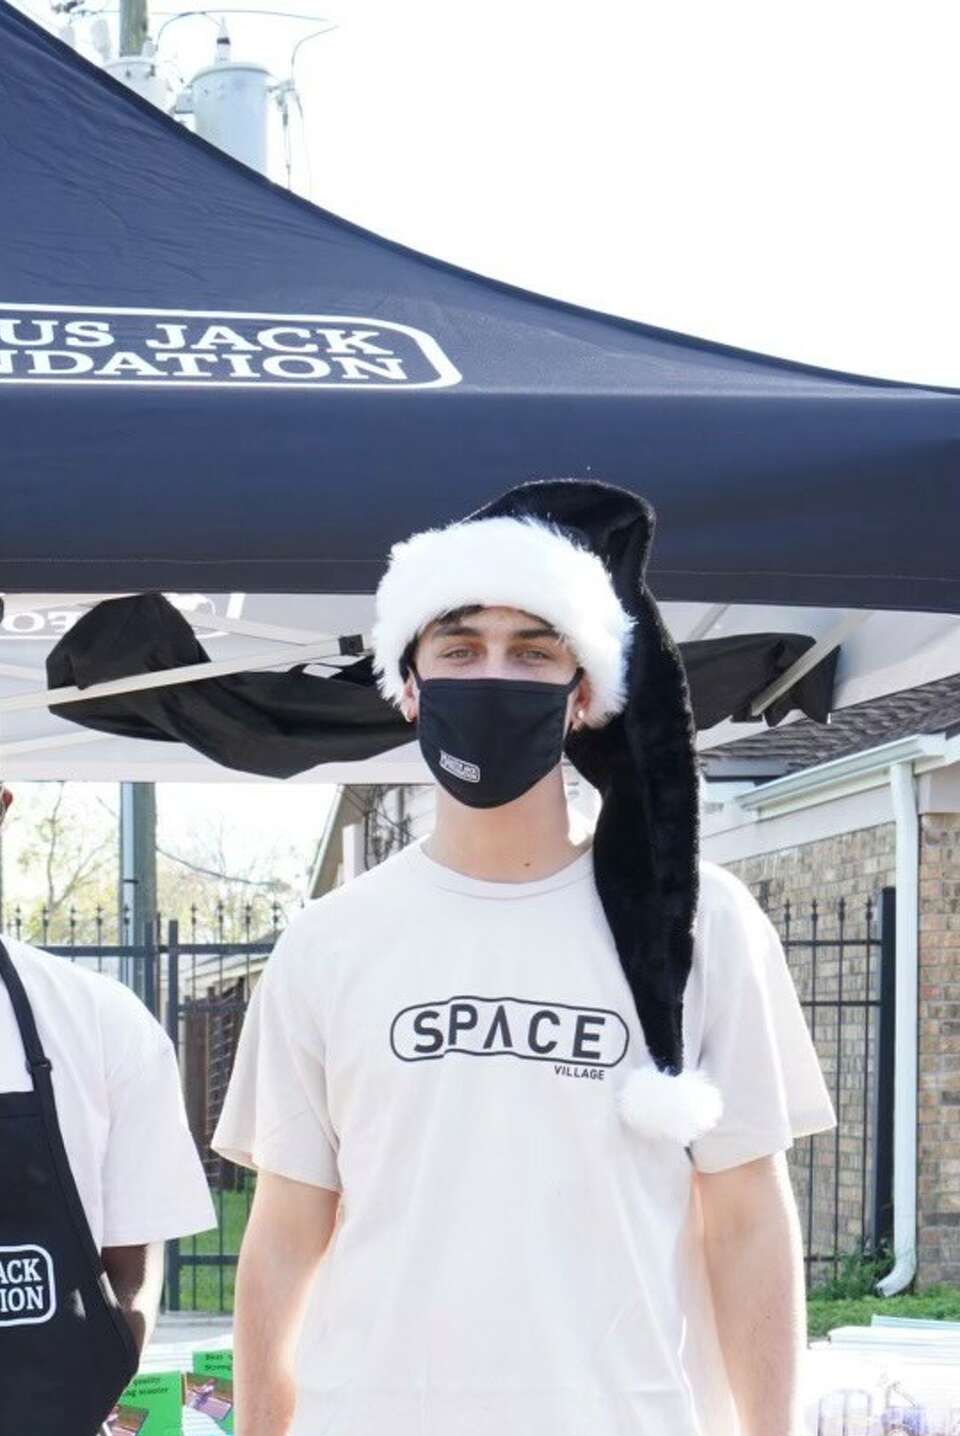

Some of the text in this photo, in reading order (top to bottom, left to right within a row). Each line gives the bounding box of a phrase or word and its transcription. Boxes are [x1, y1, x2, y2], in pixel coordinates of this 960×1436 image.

[145, 323, 395, 356] JACK
[413, 1003, 606, 1060] SPACE
[553, 1064, 605, 1081] VILLAGE
